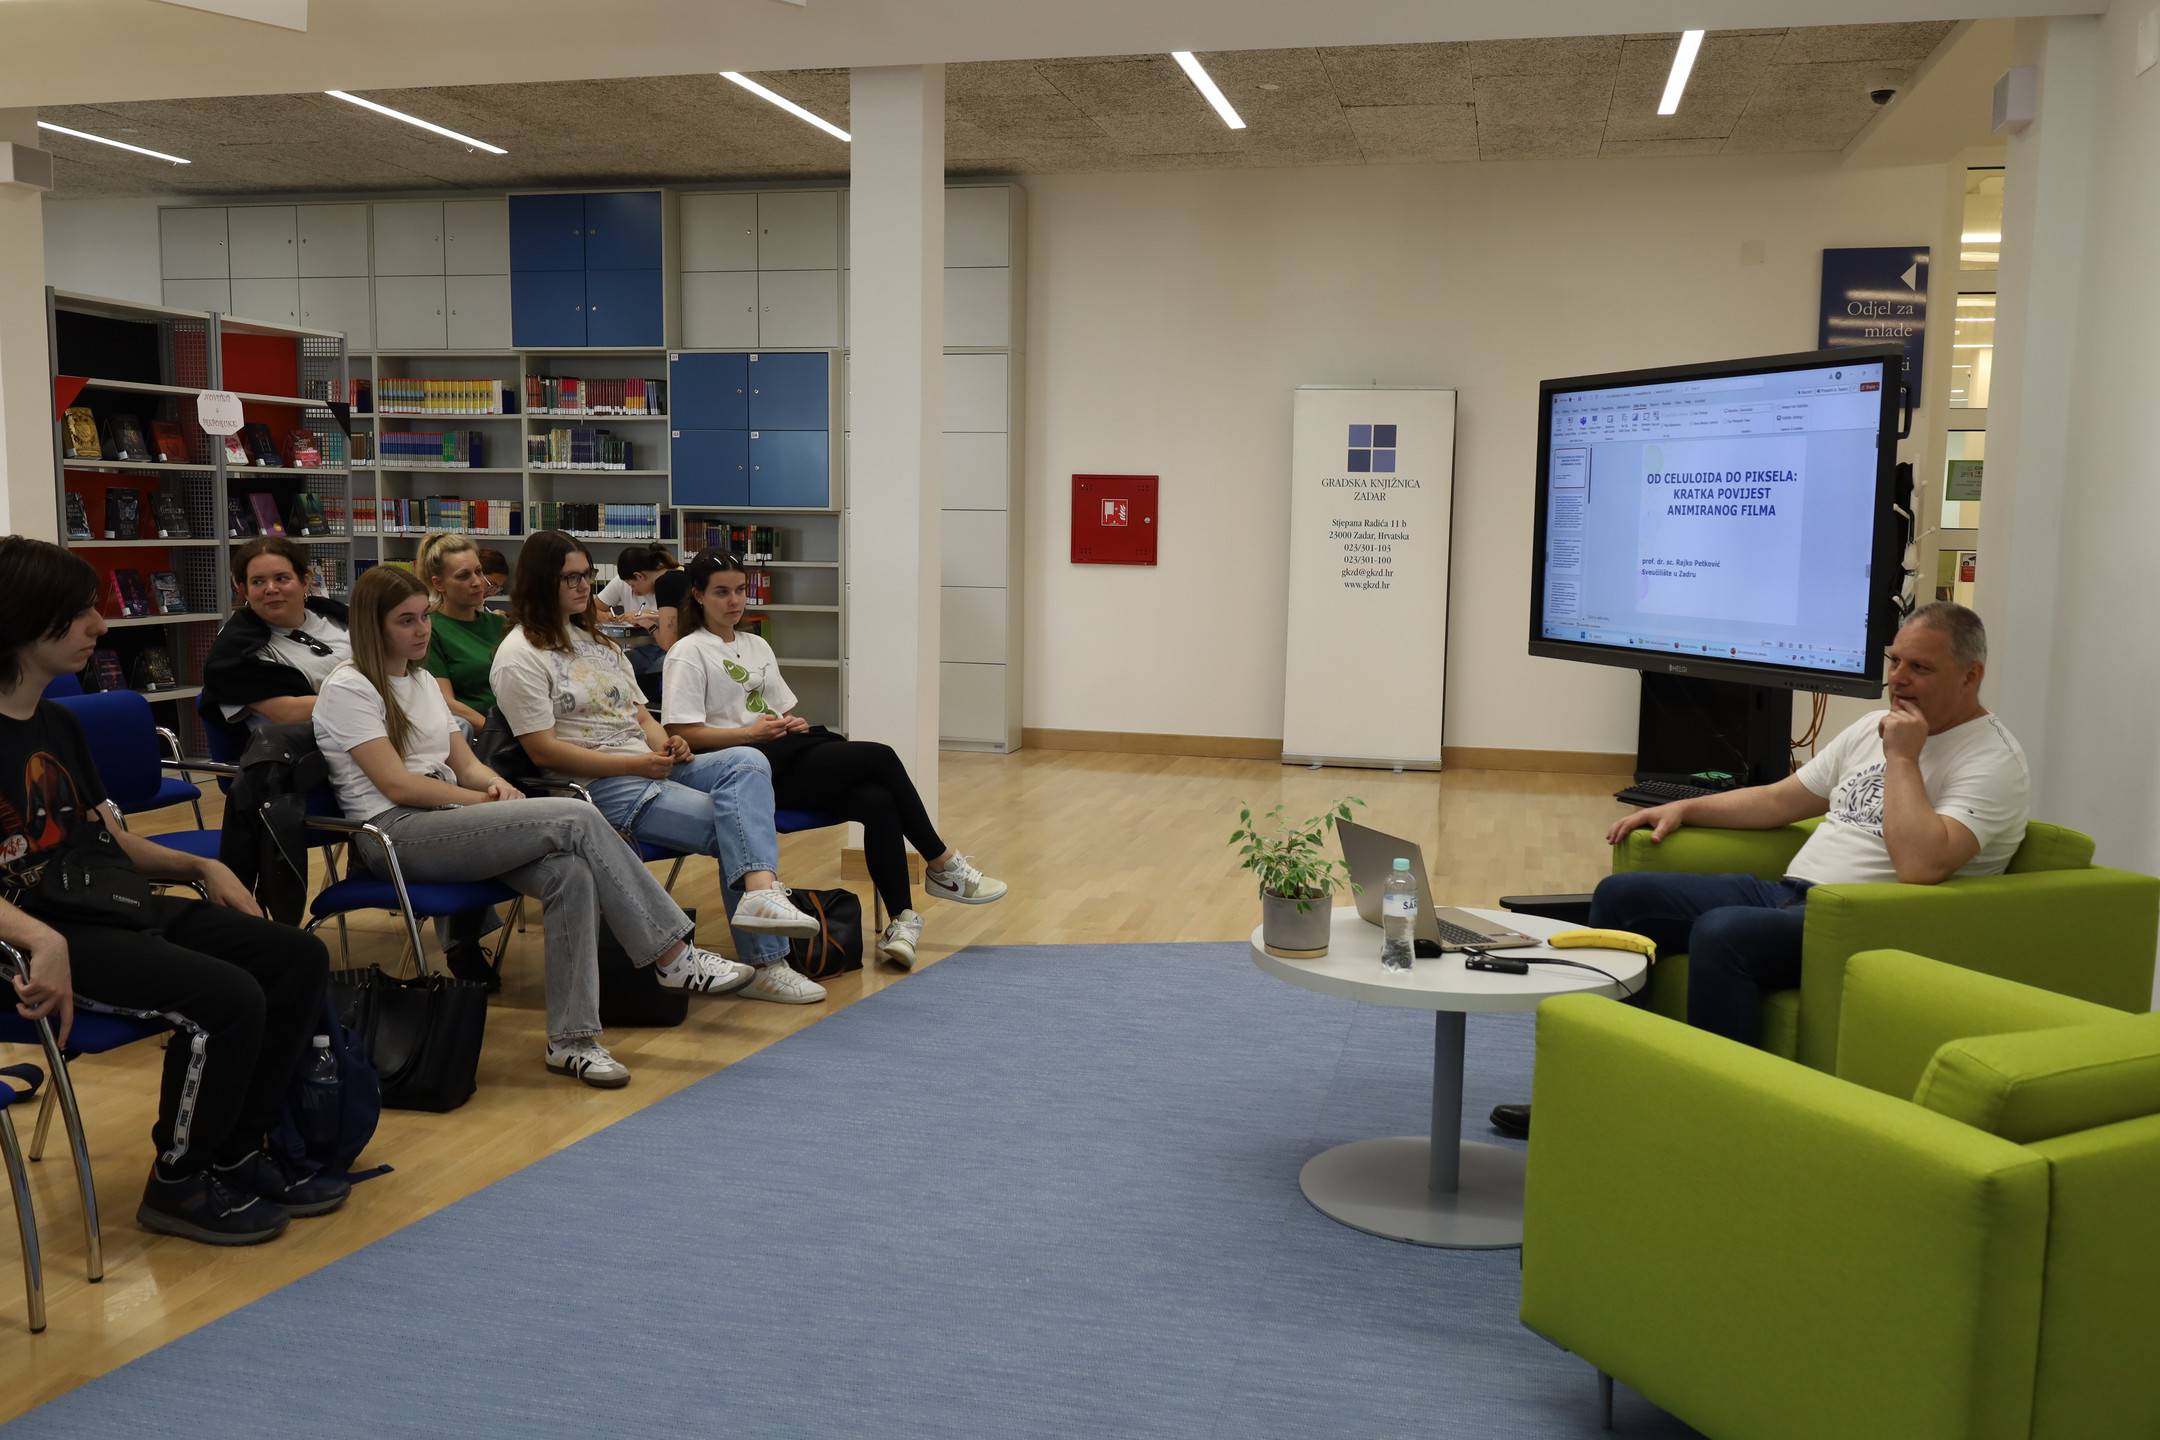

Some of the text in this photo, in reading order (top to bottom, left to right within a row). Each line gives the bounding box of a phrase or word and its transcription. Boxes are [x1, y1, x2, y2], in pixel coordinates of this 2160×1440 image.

[1847, 301, 1913, 319] Odjel za
[1864, 323, 1913, 337] mlade
[1647, 470, 1797, 484] OD CELULOIDA DO PIKSELA:
[1321, 477, 1421, 490] GRADSKA KNJIŽNICA
[1353, 492, 1387, 501] ZADAR
[1673, 488, 1771, 499] KRATKA POVIJEST
[1667, 505, 1776, 516] ANIMIRANOG FILMA
[1332, 518, 1362, 528] Stjepana
[1364, 519, 1389, 527] Radića
[1401, 519, 1407, 527] b
[1328, 531, 1410, 541] 23000 Zadar, Hrvatska
[1343, 543, 1391, 552] 023/301-103
[1343, 555, 1392, 564] 023/301-100
[1341, 568, 1394, 578] gkzd@gkzd.hr
[1343, 580, 1391, 590] www.gkzd.hr
